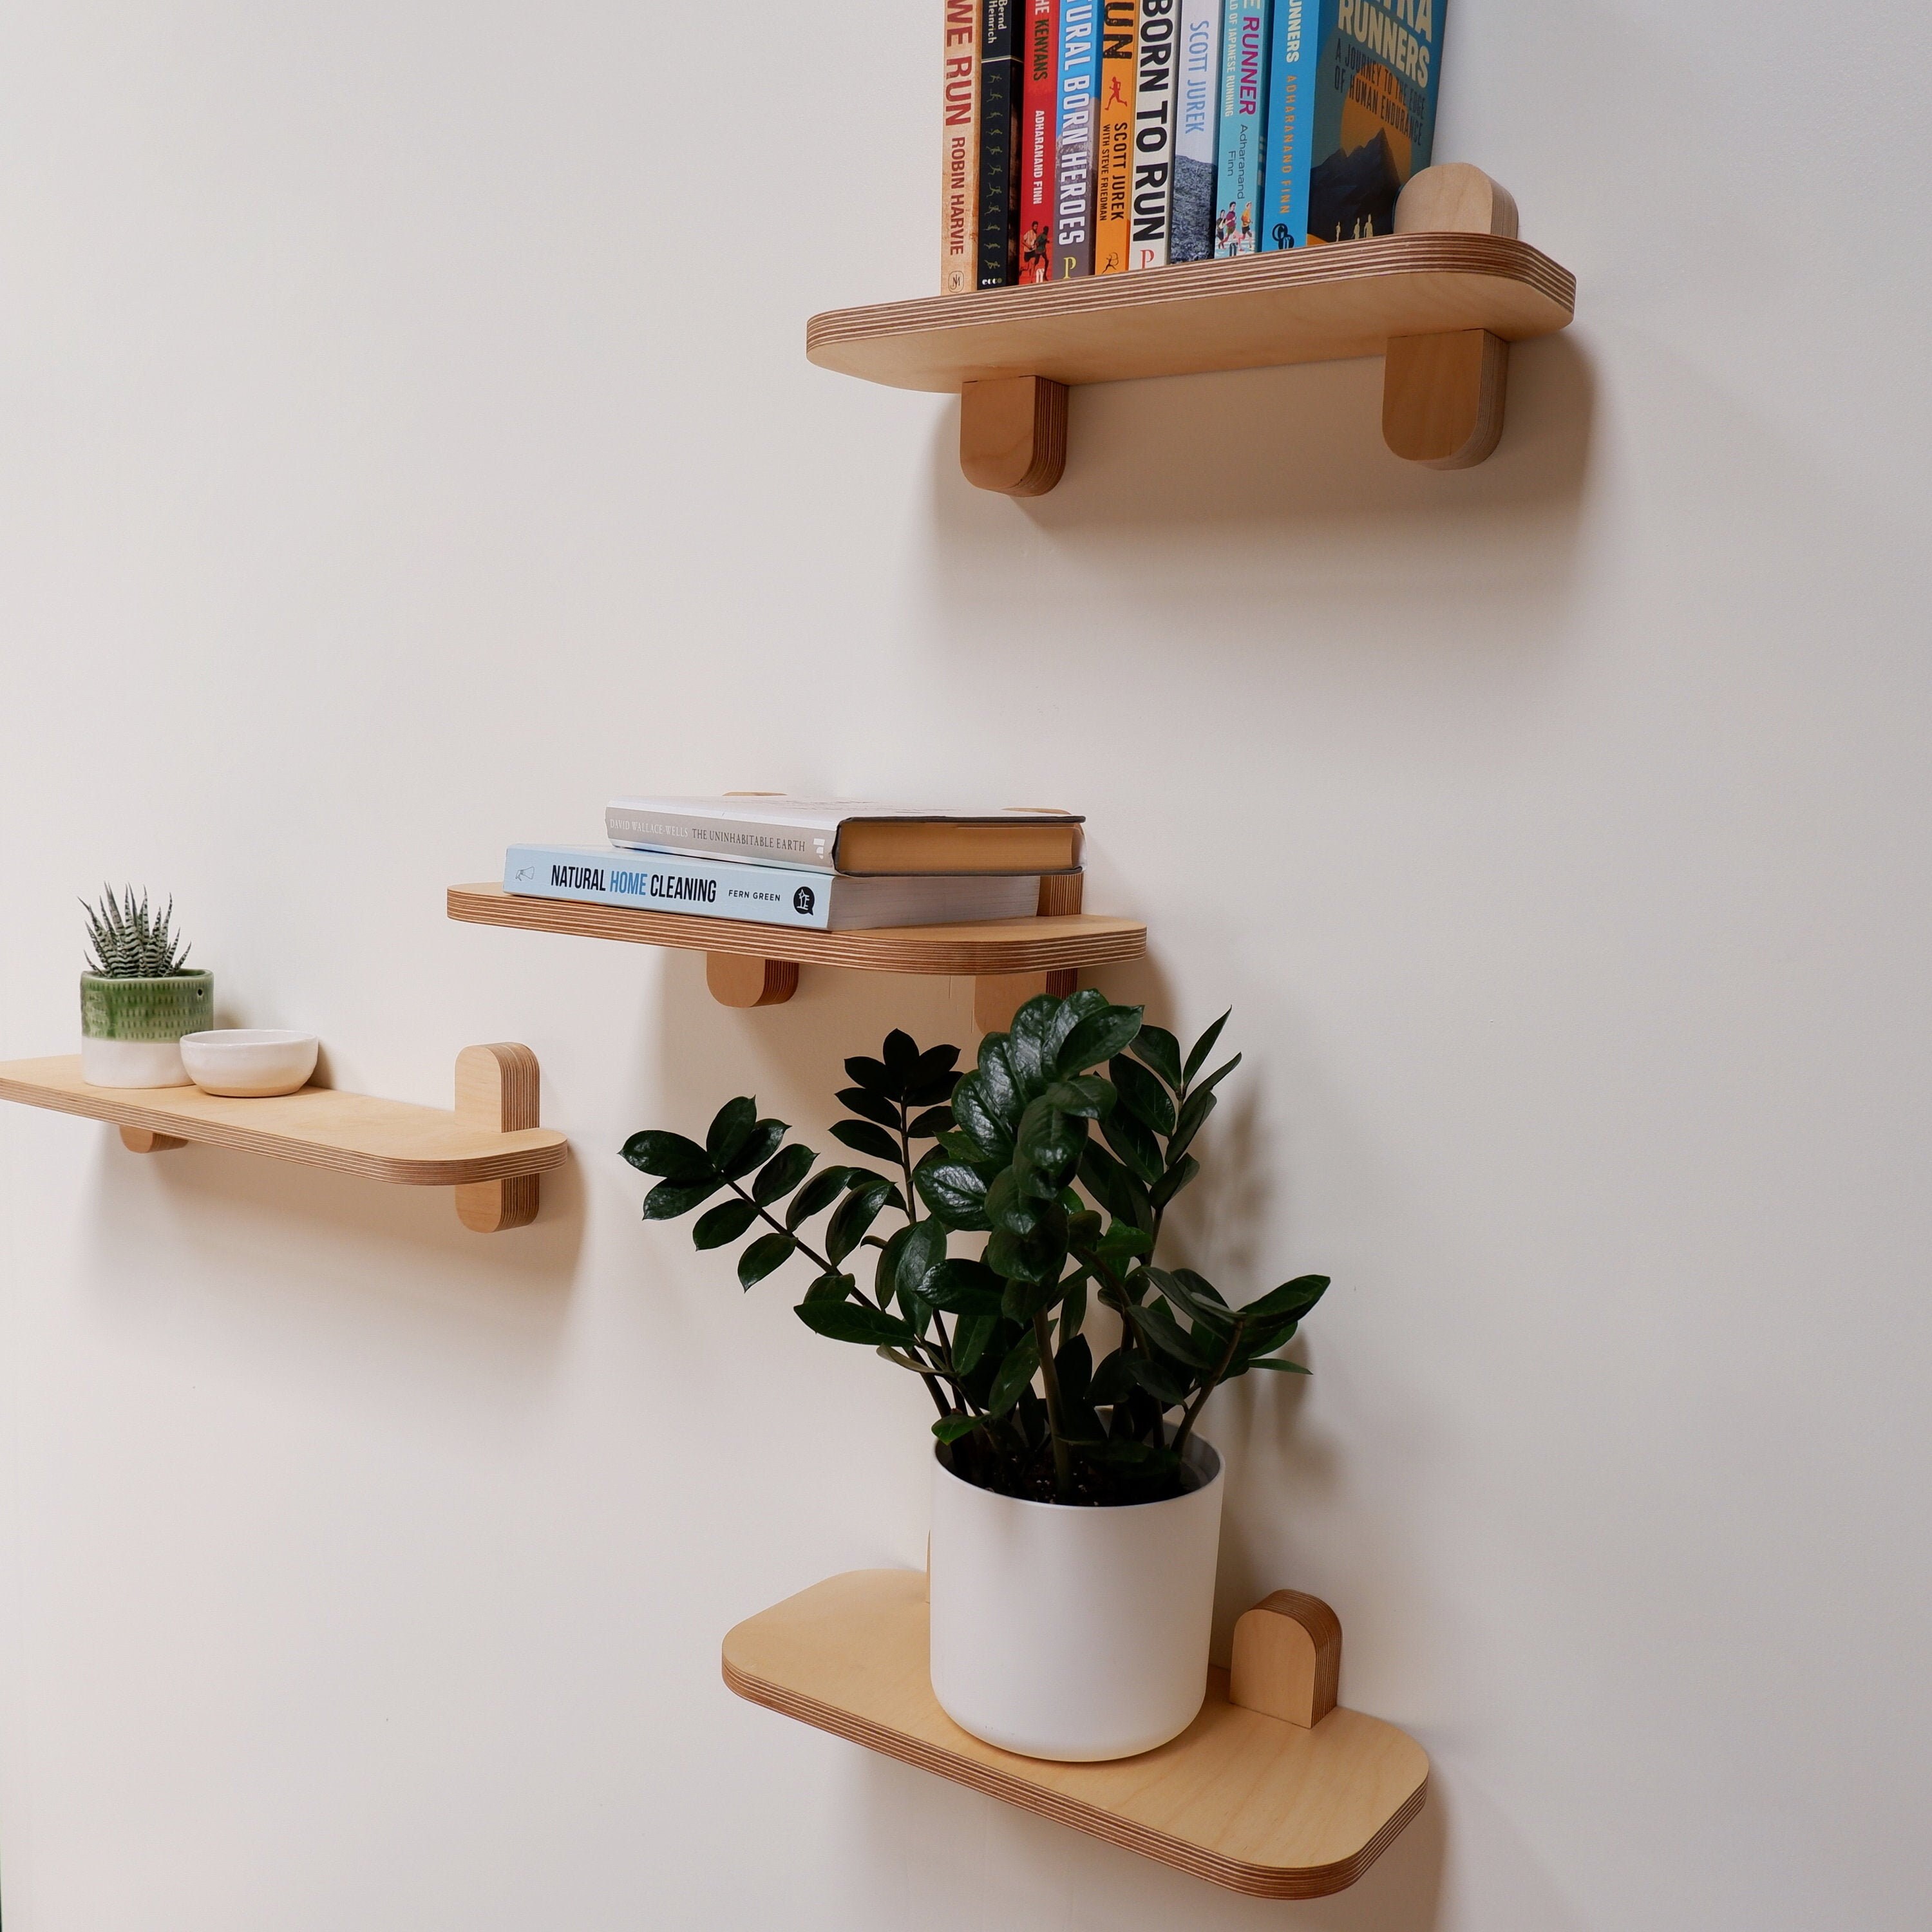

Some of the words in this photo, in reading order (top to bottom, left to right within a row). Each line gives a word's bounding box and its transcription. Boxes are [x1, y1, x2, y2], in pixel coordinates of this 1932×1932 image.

[947, 0, 973, 47] WE
[988, 0, 998, 44] Heinrich
[998, 0, 1007, 30] Bernd
[1065, 0, 1093, 71] URAL
[1229, 13, 1238, 25] OF
[1033, 19, 1049, 81] KENYANS
[1139, 0, 1173, 93] BORN
[1189, 20, 1209, 73] SCOTT
[1226, 28, 1237, 73] JAPANESE
[1239, 17, 1260, 117] RUNNER
[1338, 0, 1430, 88] RUNNERS
[945, 56, 972, 126] RUN
[1225, 75, 1235, 117] RUNNING
[1336, 38, 1341, 62] A
[1345, 44, 1382, 86] JOURNEY
[1385, 68, 1393, 95] TO
[1396, 78, 1408, 108] THE
[1410, 88, 1425, 120] EDGE
[1061, 75, 1090, 144] BORN
[1135, 100, 1168, 154] TO
[1185, 79, 1206, 135] JUREK
[1282, 75, 1297, 174] ADHARANAND
[1334, 66, 1345, 93] OF
[1349, 74, 1379, 115] HUMAN
[1381, 95, 1423, 146] ENDURANCE
[951, 137, 965, 189] ROBIN
[1034, 110, 1045, 178] ADHARANAND
[1101, 149, 1110, 175] STEVE
[1112, 123, 1128, 169] SCOTT
[1227, 151, 1237, 177] Finn
[1236, 124, 1248, 200] Adharanand
[1033, 181, 1043, 205] FINN
[1058, 151, 1088, 245] HEROES
[1099, 177, 1108, 221] FRIEDMAN
[1111, 175, 1126, 221] JUREK
[1132, 162, 1168, 243] RUN
[1279, 180, 1293, 214] FINN
[950, 194, 964, 256] HARVIE
[610, 819, 630, 830] DAVID
[632, 821, 688, 837] WALLACE-WELLS
[692, 828, 707, 840] THE
[709, 830, 774, 848] UNINHABITABLE
[777, 838, 806, 852] EARTH
[551, 864, 606, 892] NATURAL
[609, 870, 648, 896] HOME
[650, 874, 717, 903] CLEANING
[728, 889, 750, 899] FERN
[753, 892, 781, 902] GREEN
